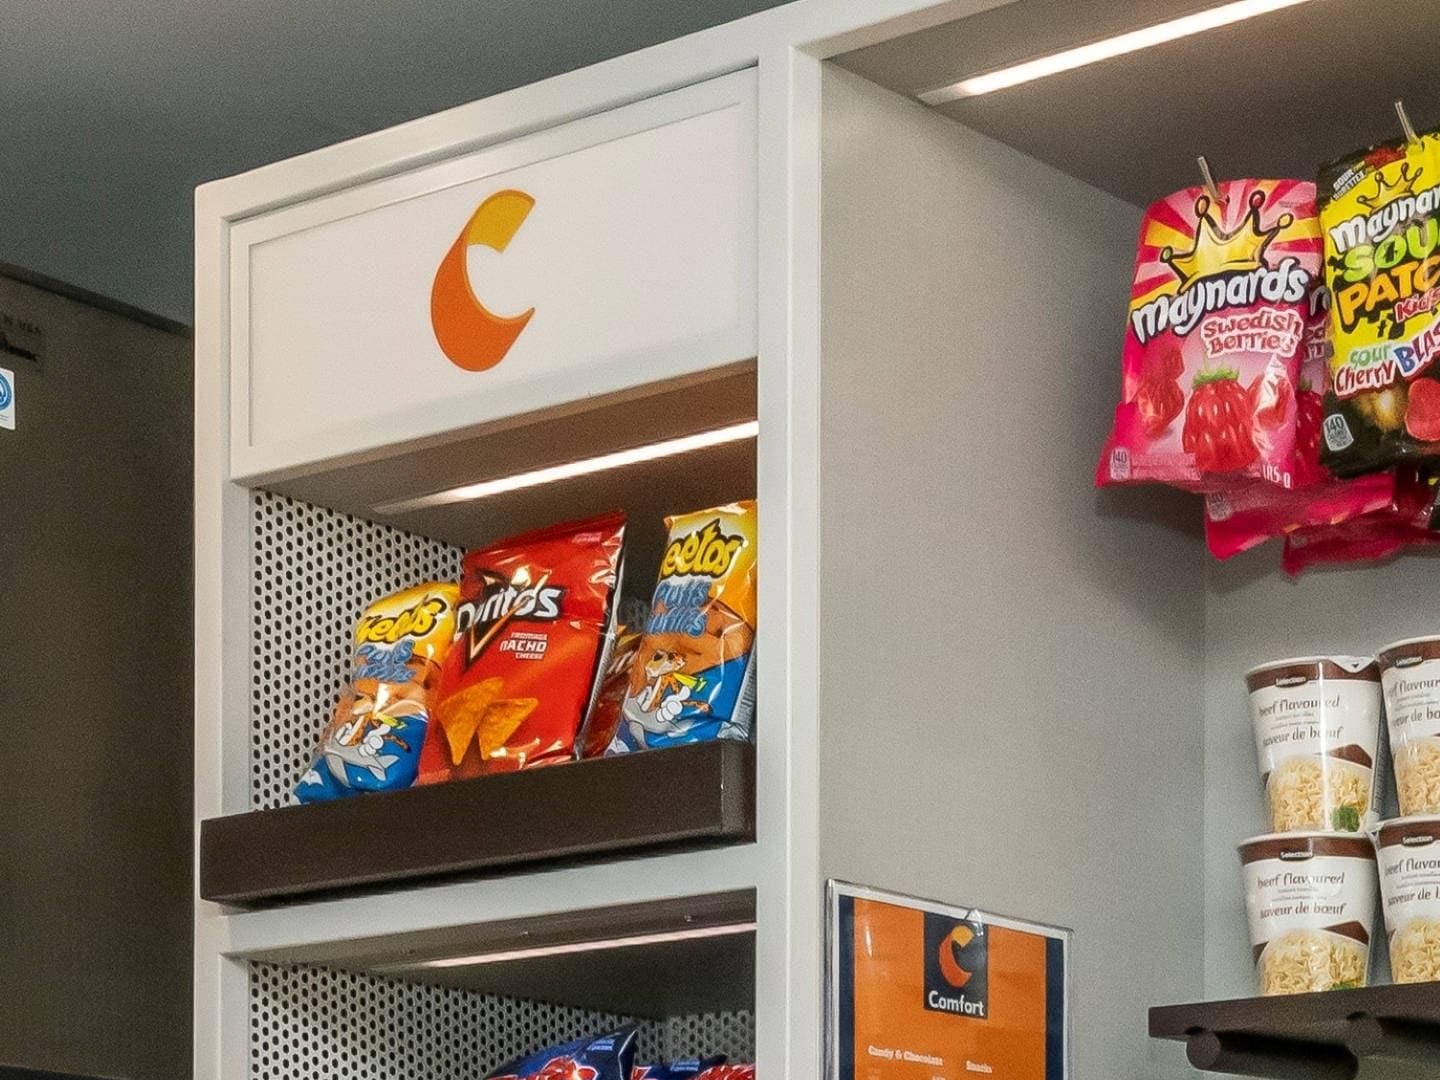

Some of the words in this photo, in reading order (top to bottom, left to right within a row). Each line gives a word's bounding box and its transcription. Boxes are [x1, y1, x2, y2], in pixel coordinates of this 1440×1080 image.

[1203, 311, 1302, 340] Swedish
[1335, 361, 1395, 398] Cherry
[457, 584, 563, 634] Doritos
[1257, 873, 1280, 890] beef
[1417, 887, 1432, 901] de
[1259, 904, 1293, 920] saveur
[1294, 901, 1310, 915] de
[928, 990, 985, 1017] Comfort
[868, 1045, 894, 1061] Candy
[904, 1051, 944, 1067] Chocolate
